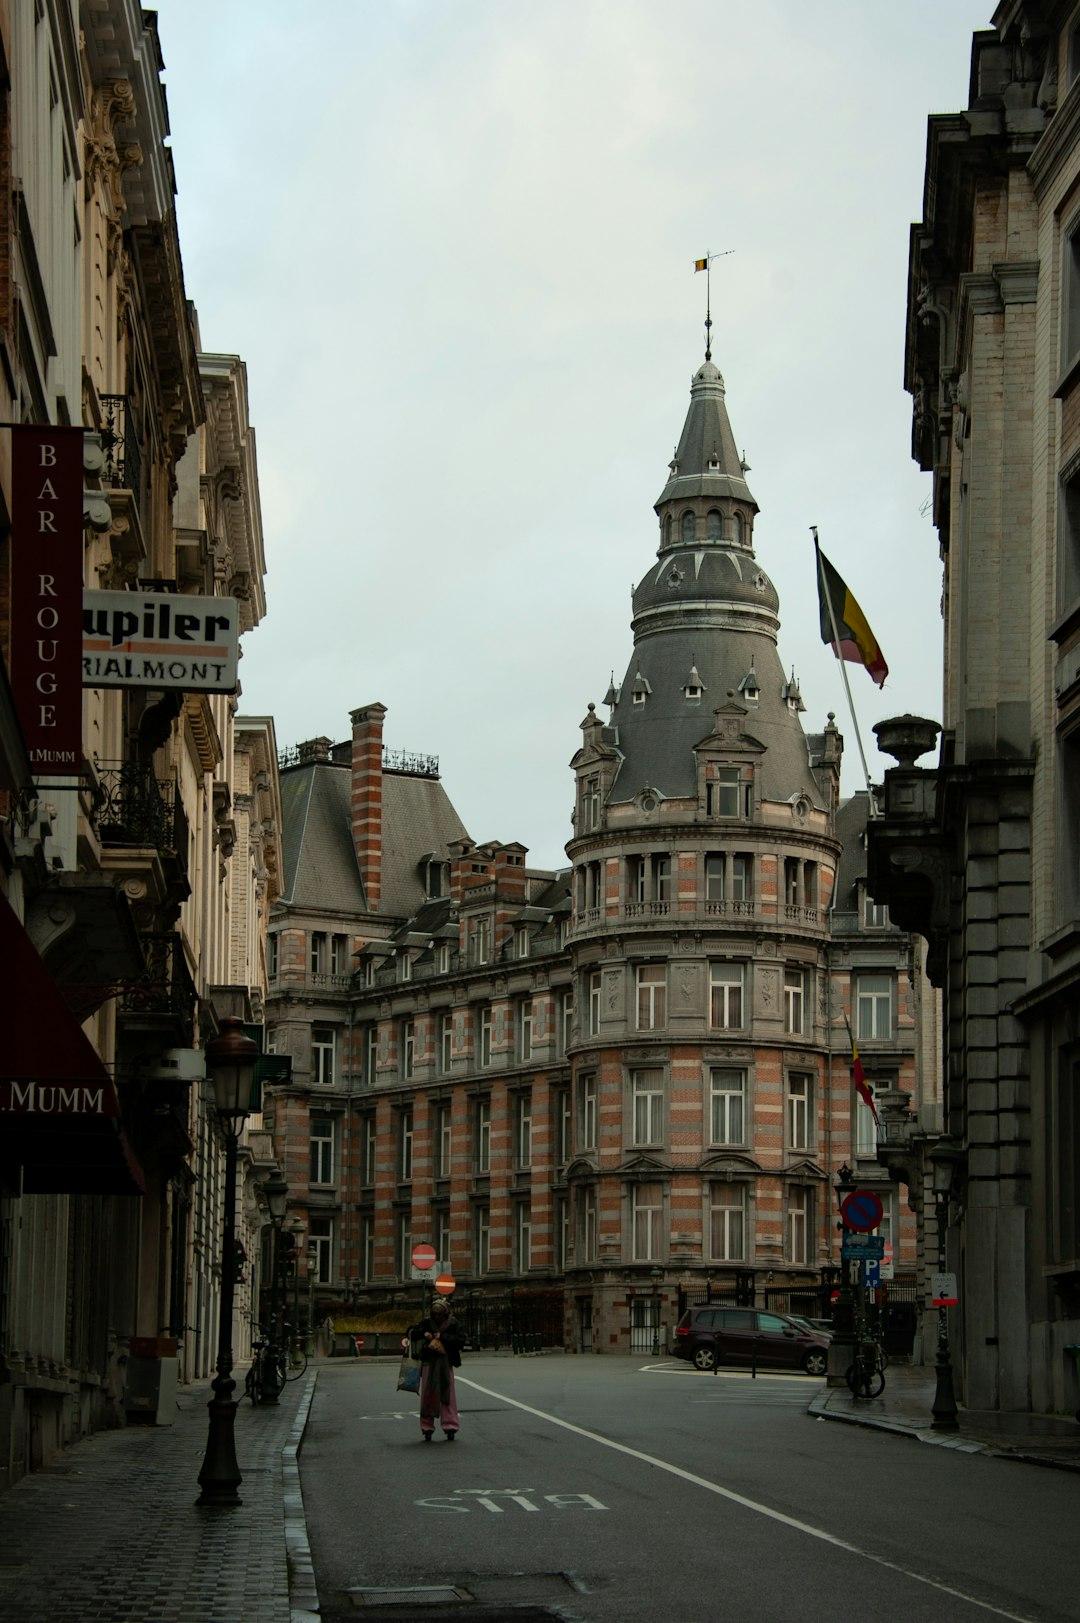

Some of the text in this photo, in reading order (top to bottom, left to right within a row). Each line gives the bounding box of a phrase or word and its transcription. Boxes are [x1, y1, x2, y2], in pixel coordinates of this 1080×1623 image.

[36, 444, 59, 728] BAR ROUGE
[83, 603, 229, 646] upiler
[865, 1260, 878, 1276] P
[413, 1493, 611, 1513] BUS
